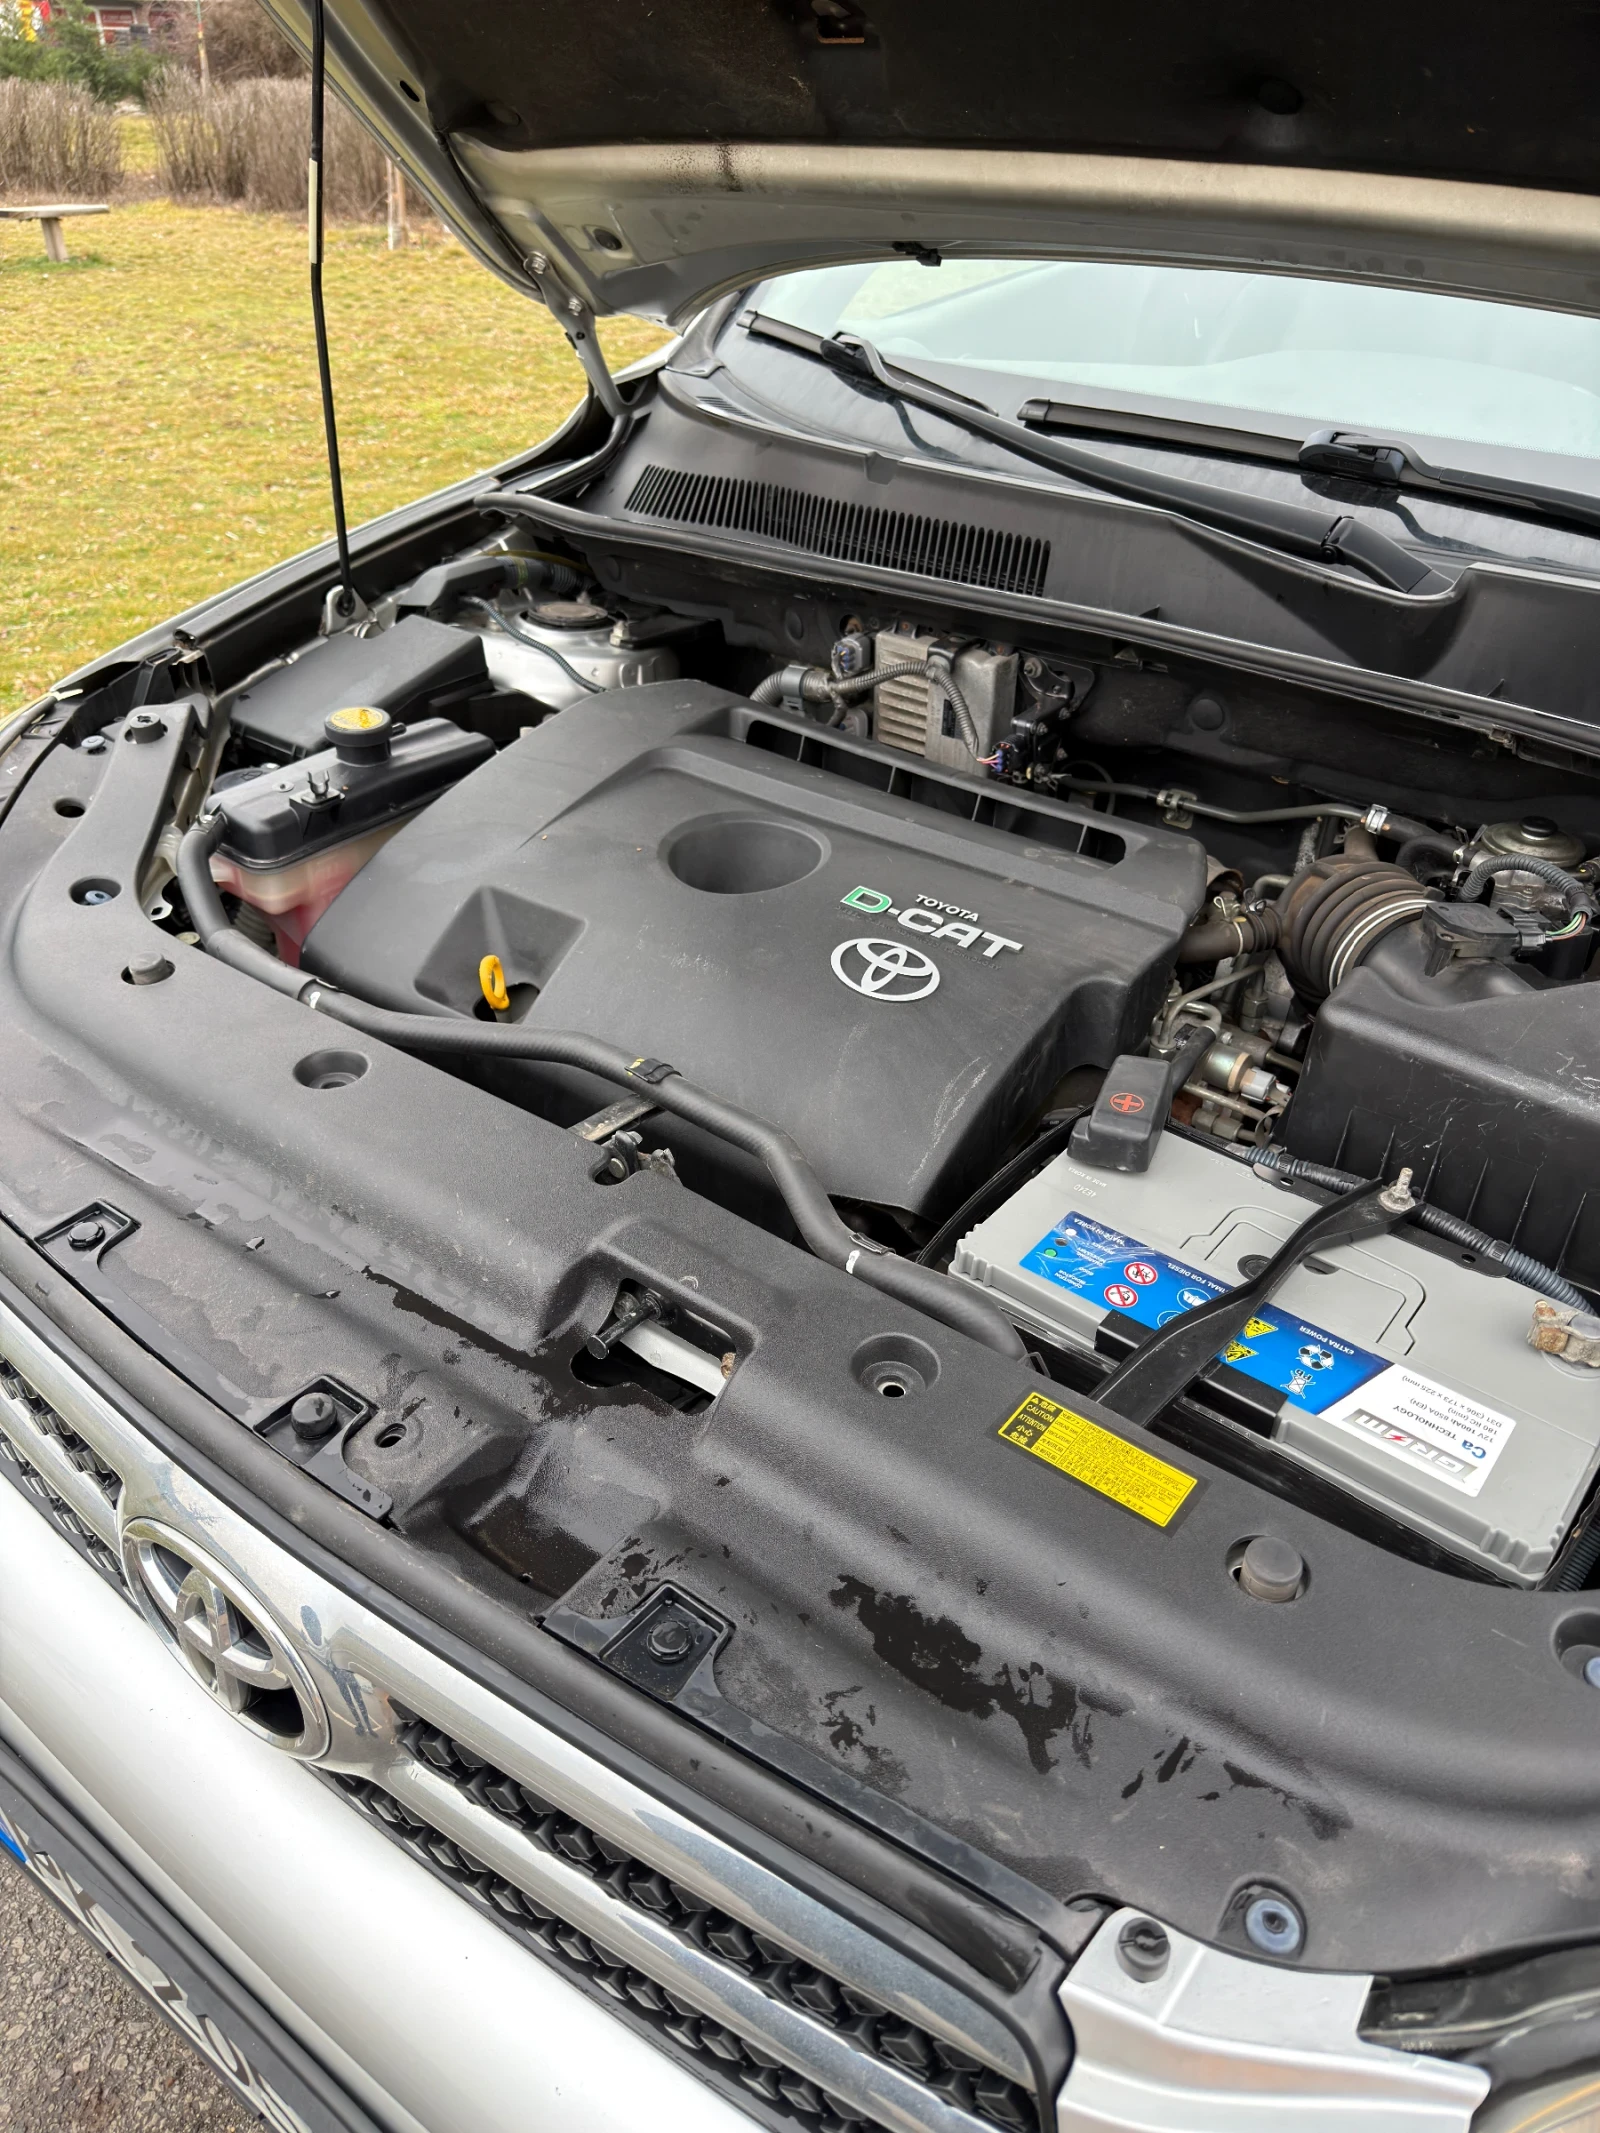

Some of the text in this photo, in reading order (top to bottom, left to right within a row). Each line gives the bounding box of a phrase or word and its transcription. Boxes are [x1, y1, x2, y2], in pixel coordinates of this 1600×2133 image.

[915, 894, 980, 922] TOYOTA
[840, 885, 1024, 959] D-CAT
[1072, 1217, 1096, 1230] KOREA
[1165, 1261, 1191, 1276] DIESEL
[1189, 1273, 1207, 1284] FOR
[1298, 1325, 1355, 1355] EXTRA POWER
[1292, 1367, 1313, 1381] Pb
[1400, 1374, 1421, 1388] mm)
[1419, 1384, 1436, 1395] 225
[1442, 1395, 1459, 1406] 173
[1025, 1403, 1055, 1422] CAUTION
[1017, 1412, 1047, 1431] ATTENTION
[1446, 1406, 1498, 1435] 180 RC (min)
[1449, 1417, 1476, 1434] 100Ah
[1485, 1416, 1502, 1427] D31
[1014, 1423, 1035, 1437] 小心
[1391, 1403, 1488, 1461] Ca TECHNOLOGY
[1477, 1431, 1494, 1443] 12V
